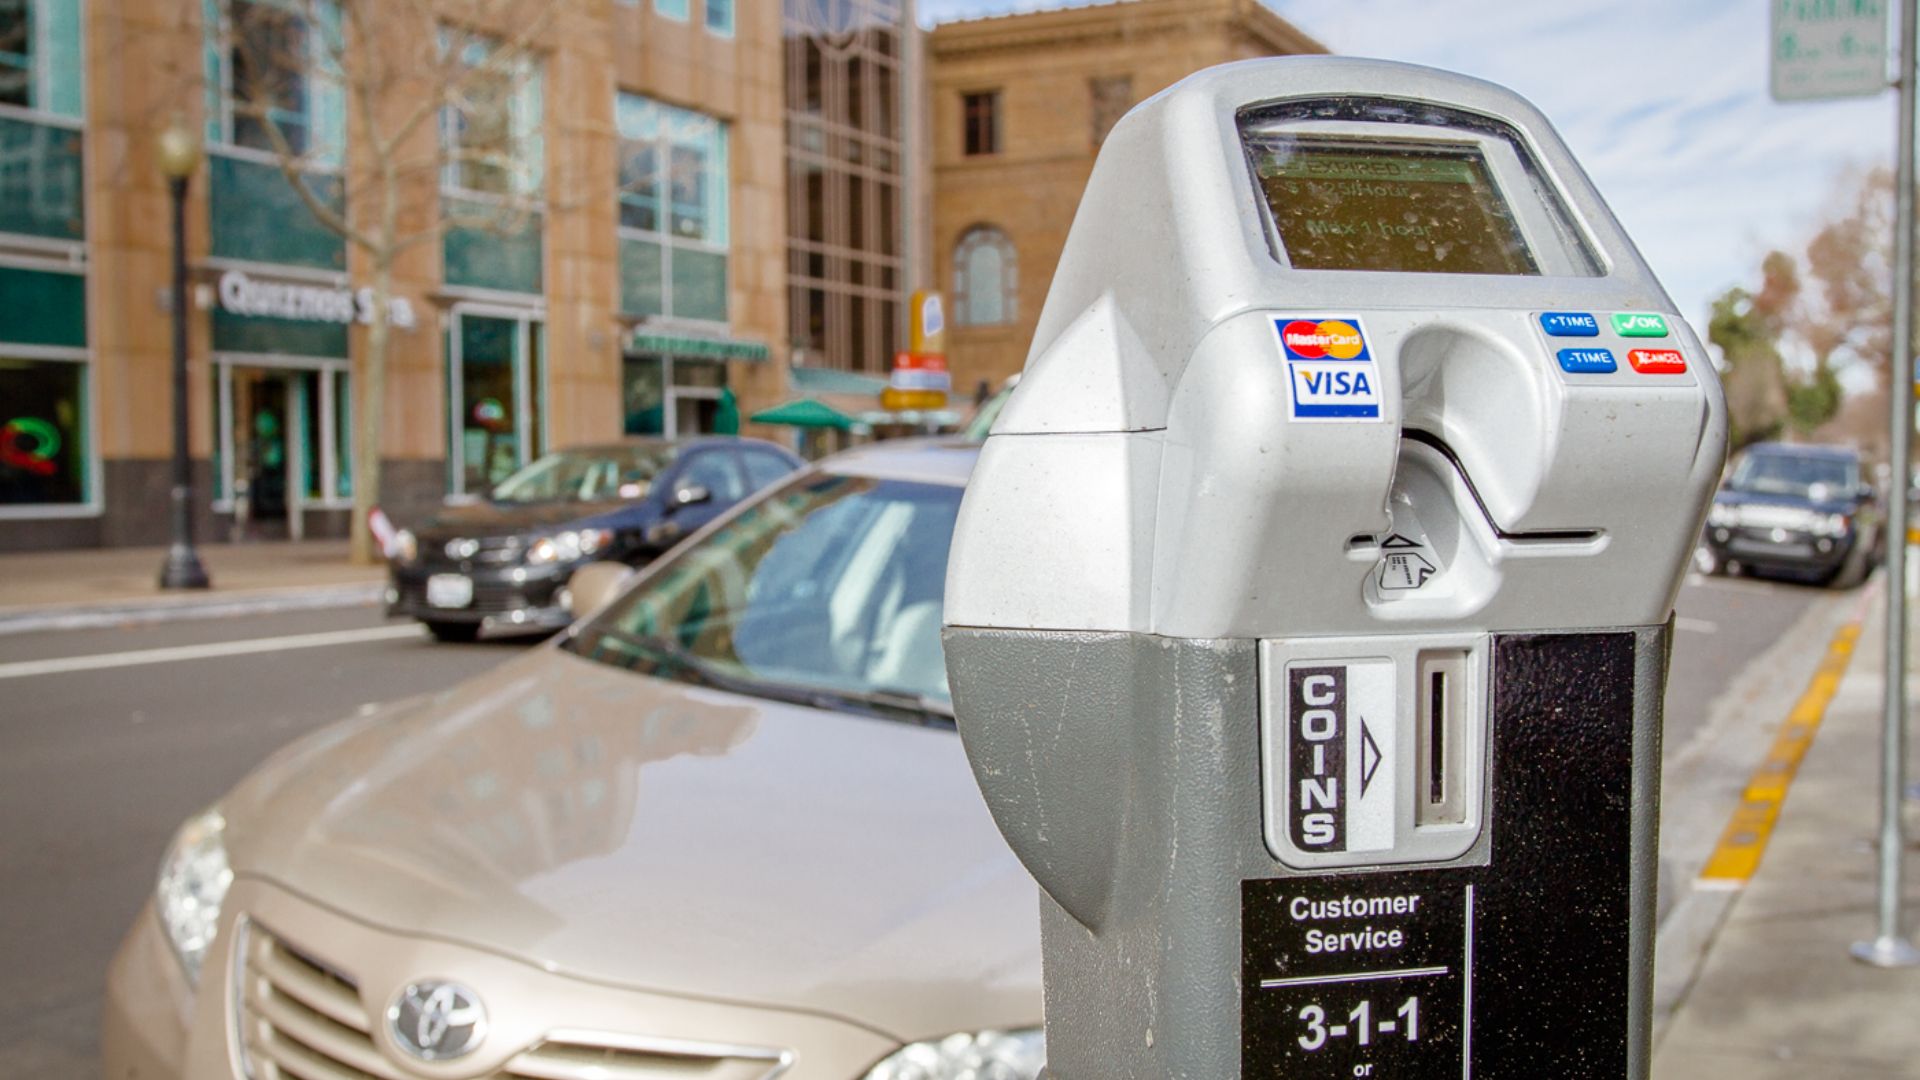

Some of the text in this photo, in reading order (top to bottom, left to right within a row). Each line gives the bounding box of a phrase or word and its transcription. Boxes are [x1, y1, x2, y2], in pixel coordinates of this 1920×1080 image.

[1308, 161, 1402, 176] EXPIRED
[1305, 219, 1432, 237] Max 1 hour
[1550, 316, 1595, 327] +TIME
[1638, 317, 1662, 328] OK
[1286, 333, 1361, 346] MasterCard
[1569, 352, 1612, 363] -TIME
[1298, 371, 1371, 395] VISA
[1300, 674, 1337, 845] COINS
[1290, 894, 1419, 920] Customer
[1305, 926, 1402, 953] Service
[1298, 996, 1419, 1050] 3-1-1
[1353, 1061, 1372, 1077] or
